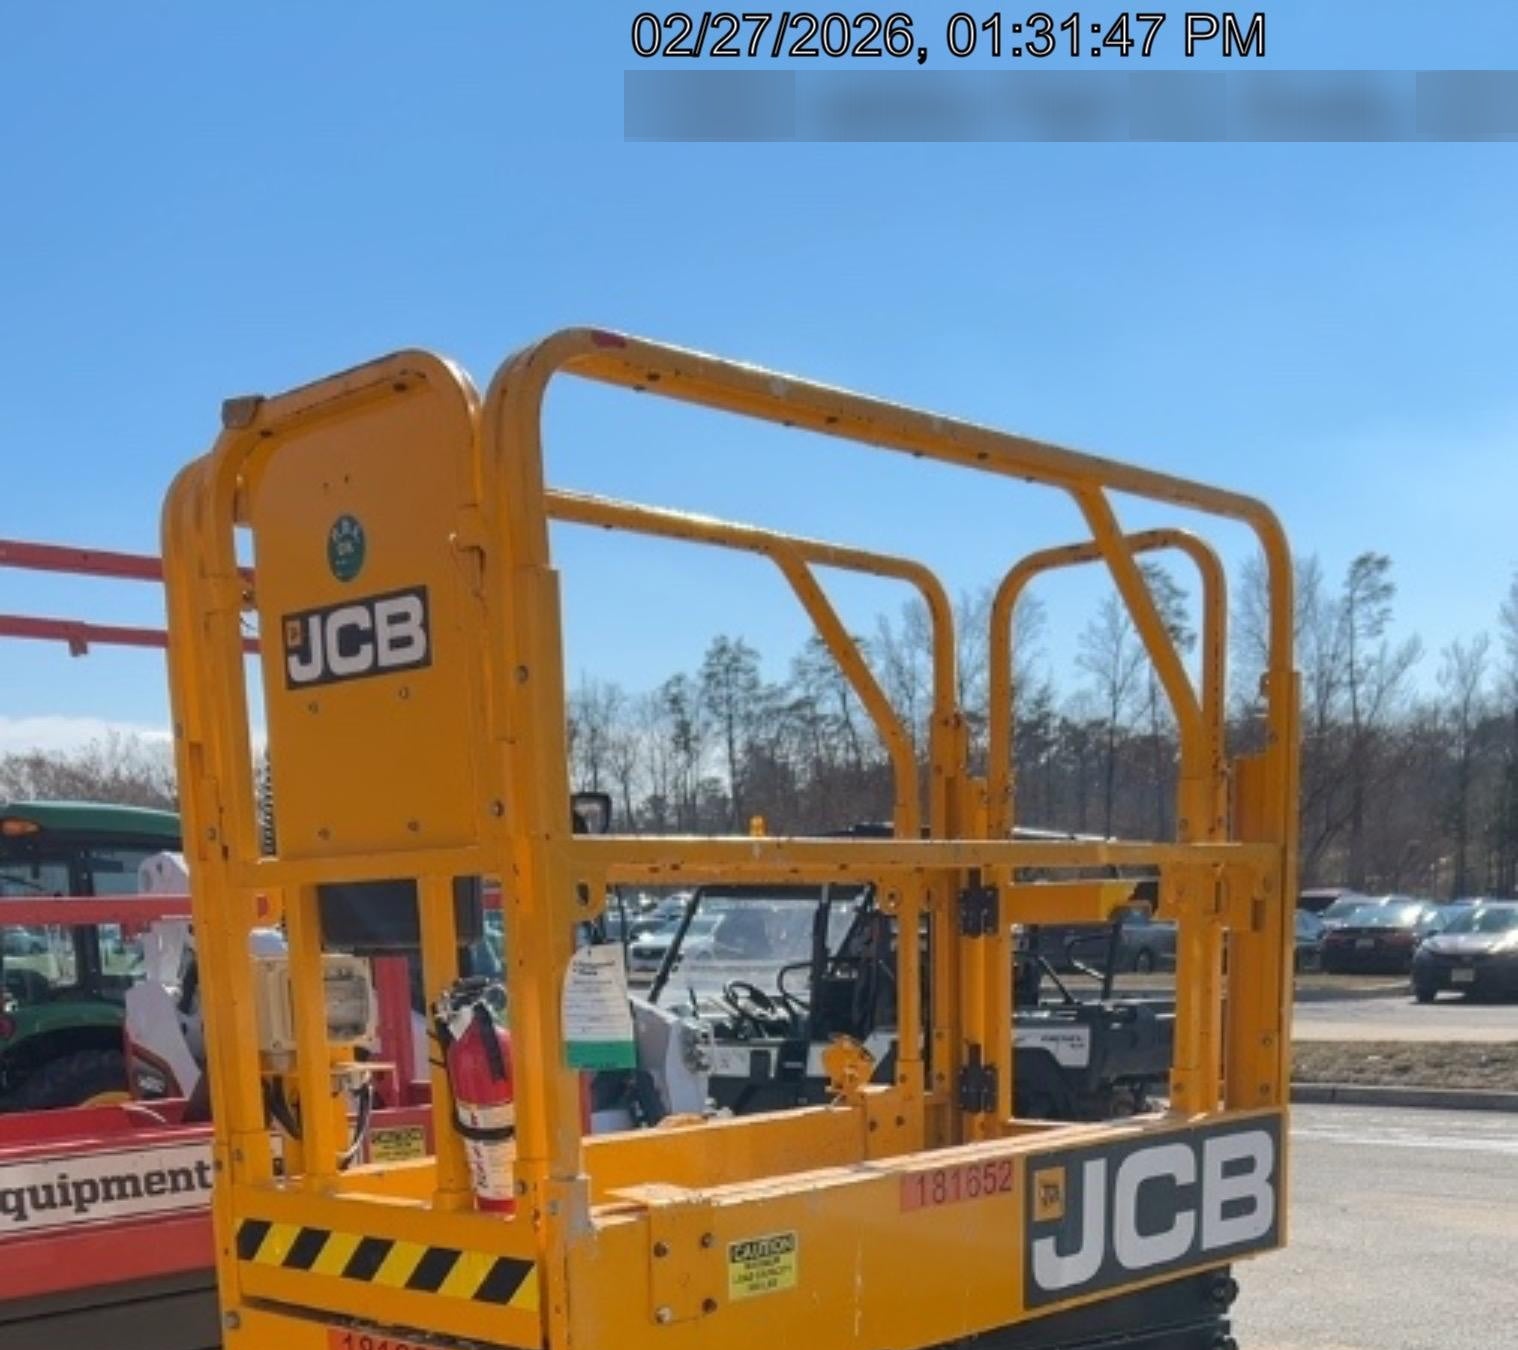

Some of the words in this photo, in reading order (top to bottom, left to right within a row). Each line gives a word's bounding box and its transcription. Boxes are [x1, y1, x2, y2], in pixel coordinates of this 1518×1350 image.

[287, 594, 426, 682] JCB
[917, 1161, 1012, 1206] 181652
[1031, 1130, 1275, 1291] JCB
